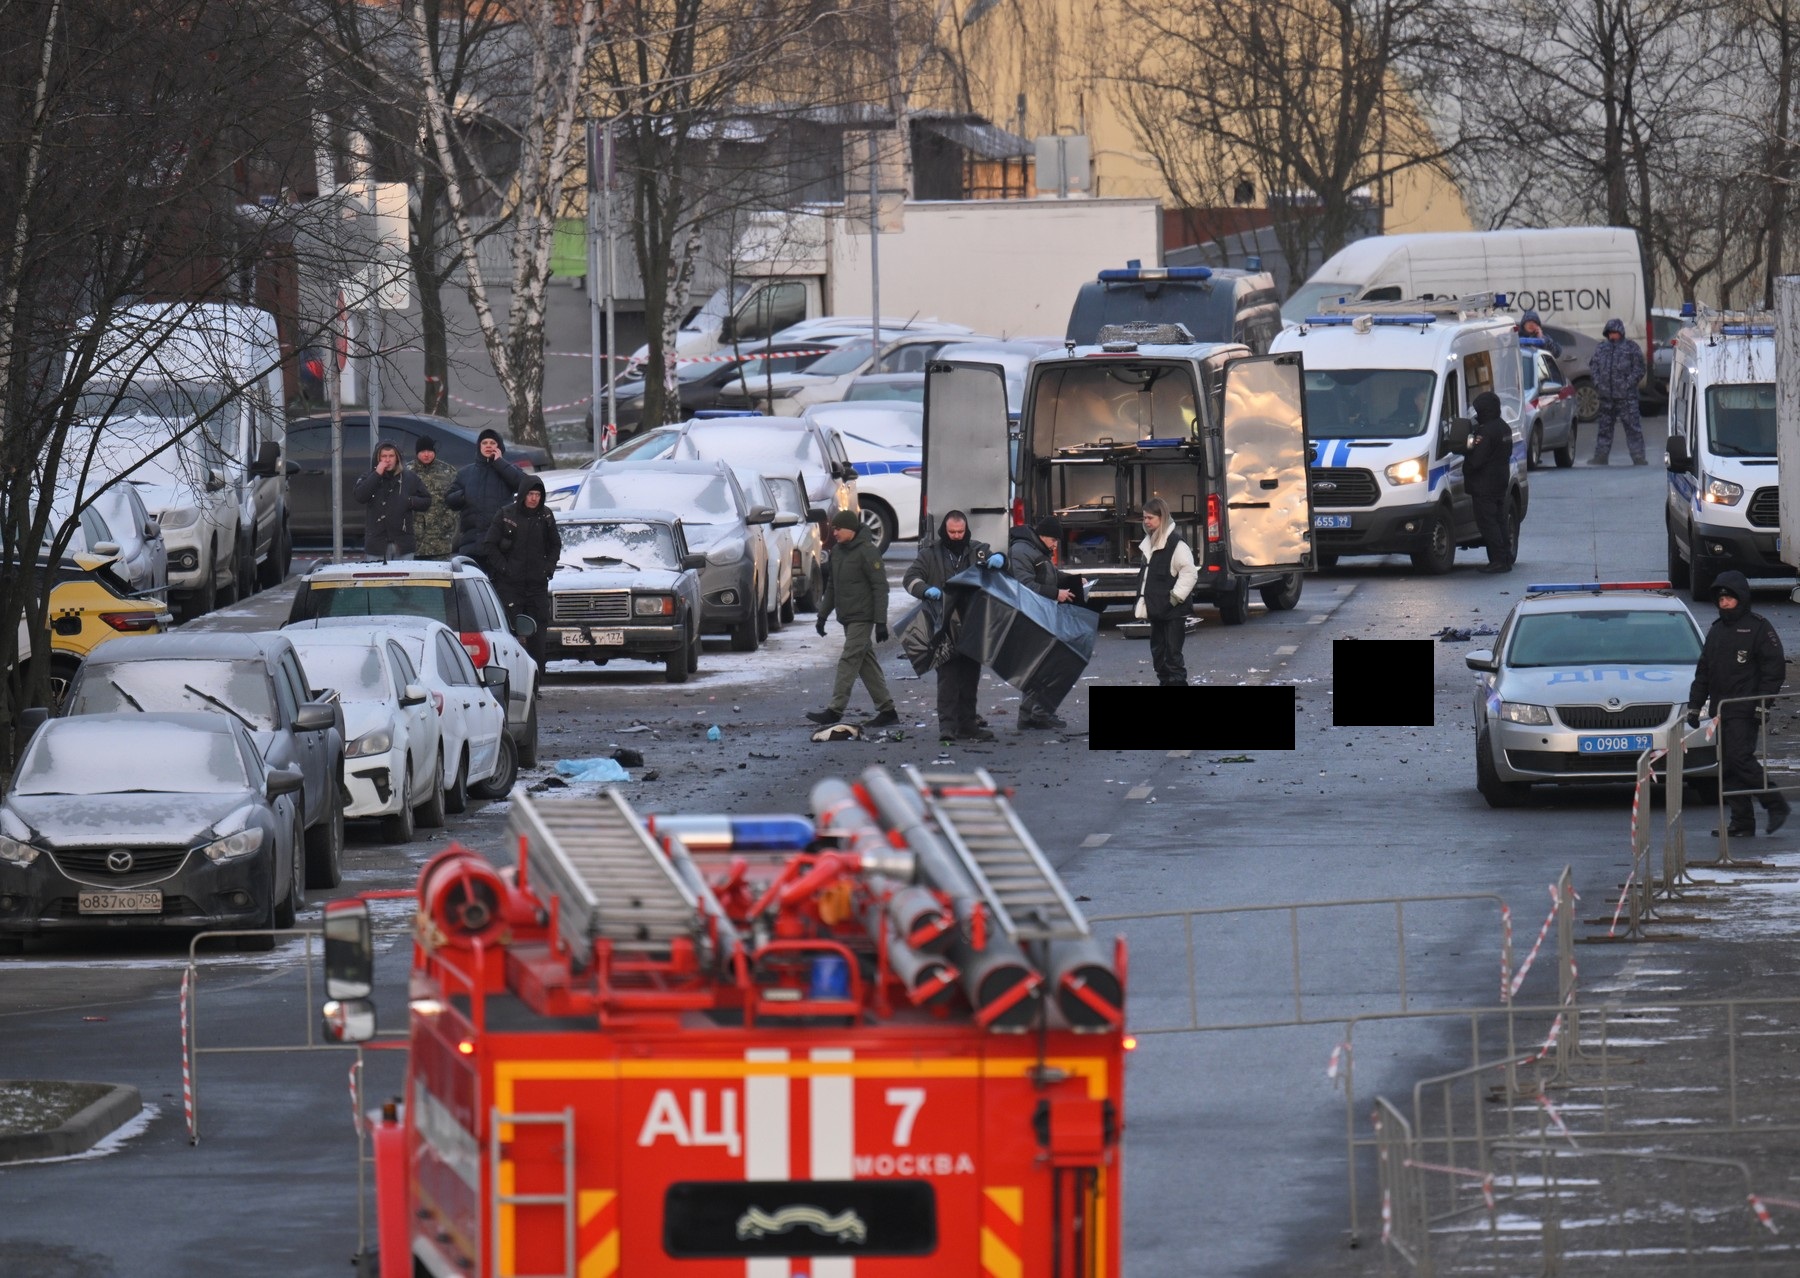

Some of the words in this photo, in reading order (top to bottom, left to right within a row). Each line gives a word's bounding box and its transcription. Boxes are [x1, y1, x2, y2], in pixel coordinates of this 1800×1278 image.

[1484, 288, 1611, 312] ZOBETON
[1339, 516, 1348, 525] 99
[606, 633, 621, 641] 177
[1547, 668, 1673, 685] ДПС
[1597, 738, 1628, 750] 0908
[1636, 736, 1648, 745] 99
[83, 895, 136, 909] О837КО
[138, 893, 158, 904] 750
[638, 1089, 741, 1157] АЦ
[885, 1088, 926, 1147] 7
[852, 1154, 975, 1176] МОСКВА
